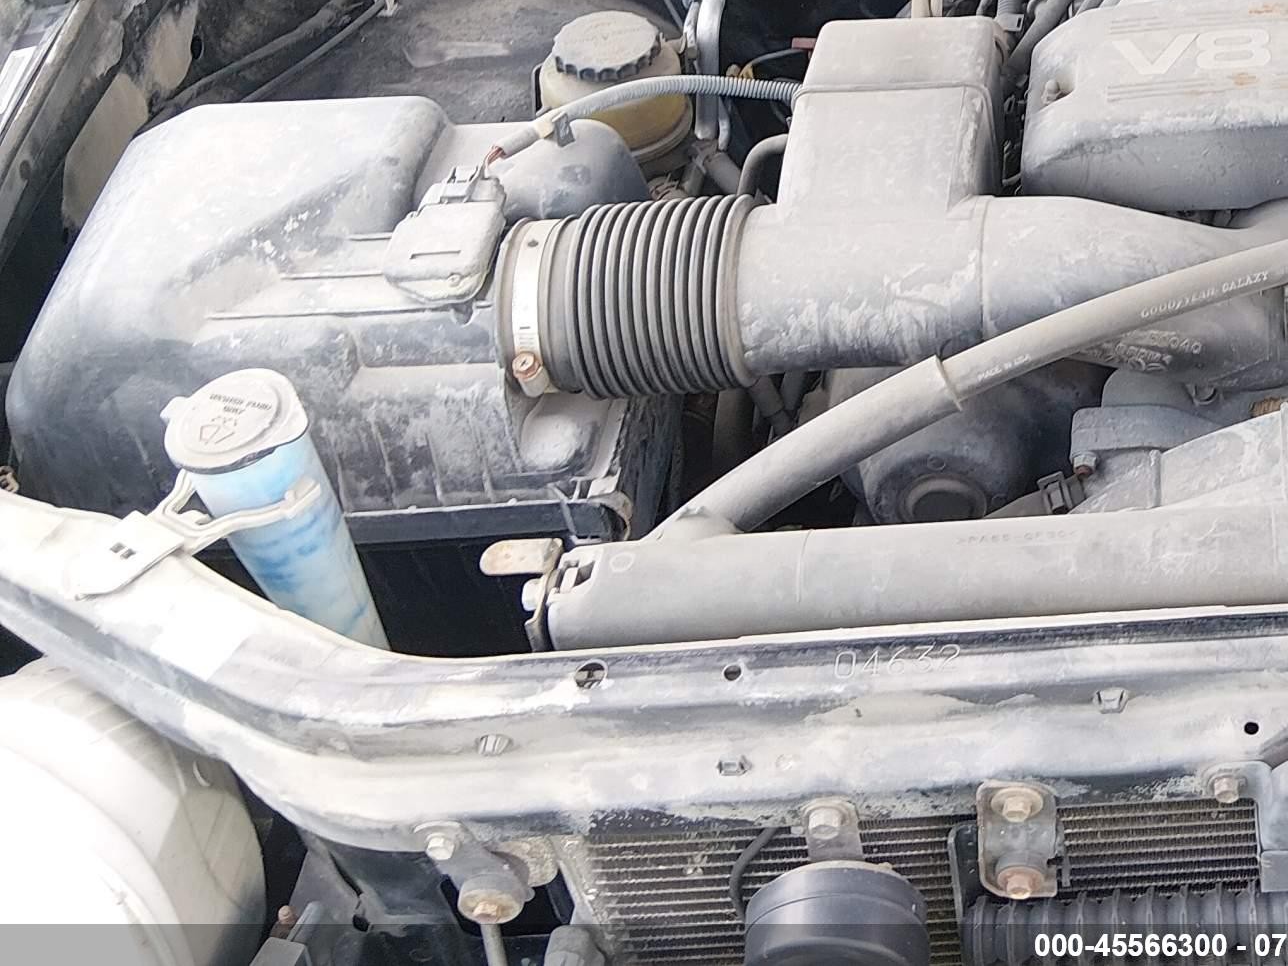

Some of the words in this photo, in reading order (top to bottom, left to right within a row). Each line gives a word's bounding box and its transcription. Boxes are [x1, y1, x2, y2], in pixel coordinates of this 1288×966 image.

[1111, 27, 1272, 76] V8
[1221, 270, 1269, 294] GALAXY
[834, 643, 961, 680] 04632
